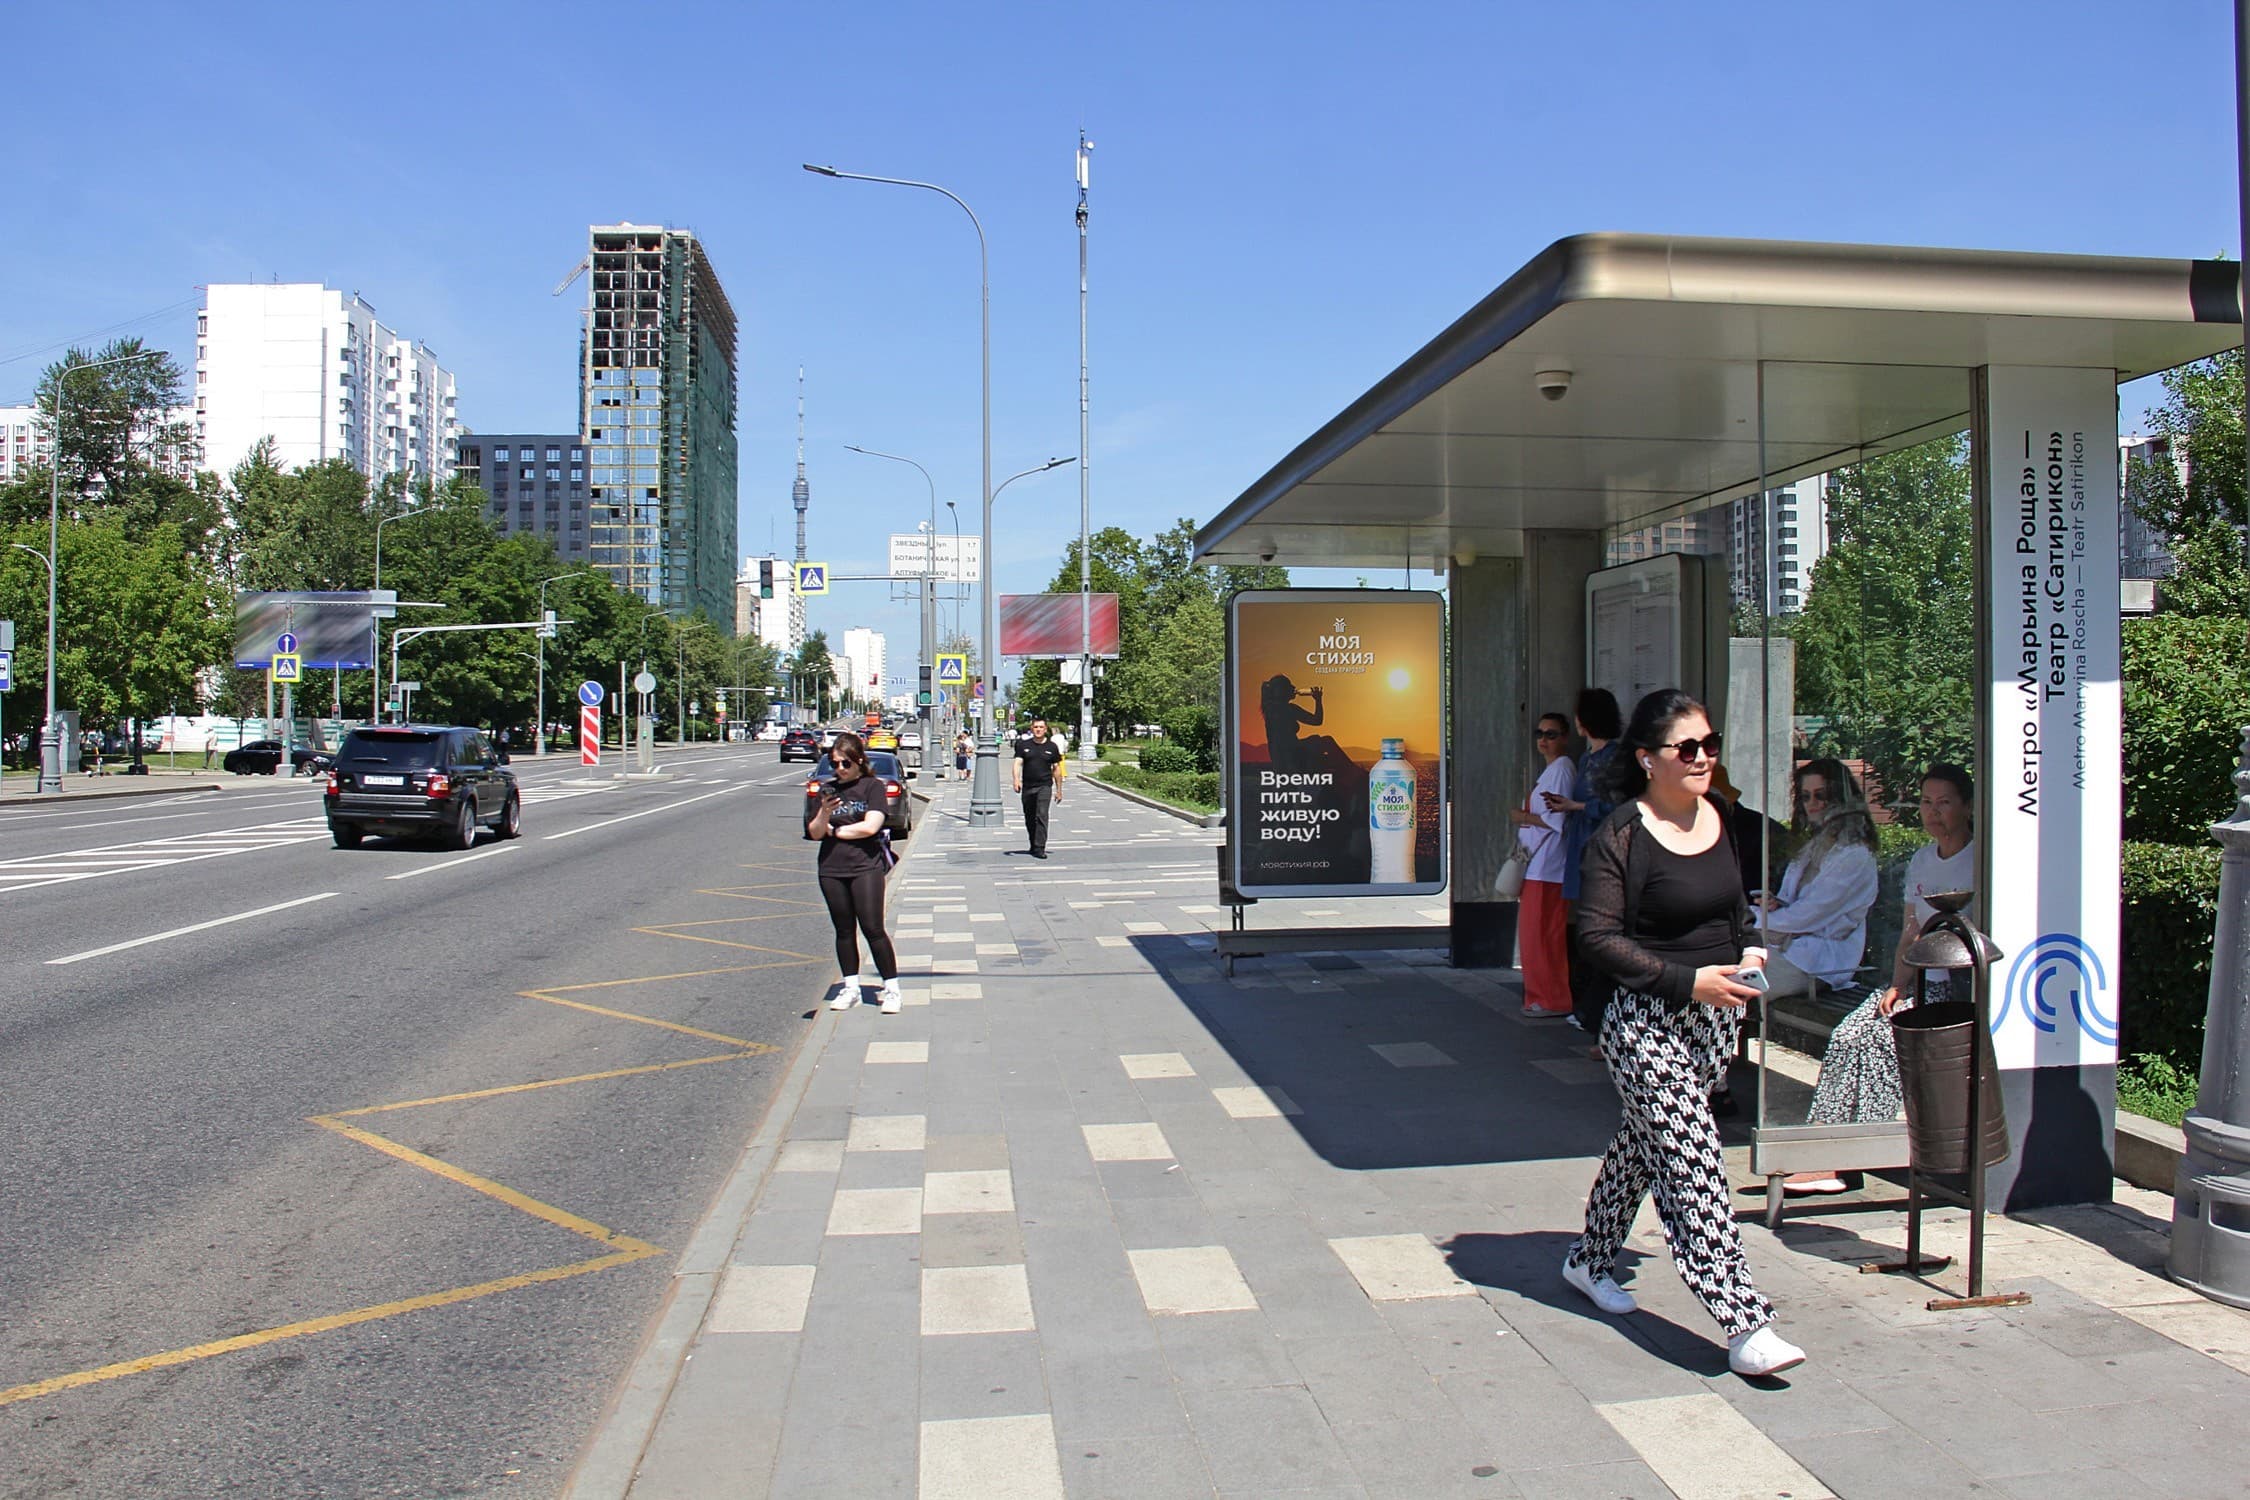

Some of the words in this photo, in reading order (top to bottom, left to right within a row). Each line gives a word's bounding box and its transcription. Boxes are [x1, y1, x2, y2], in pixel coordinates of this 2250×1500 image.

[2070, 431, 2085, 511] Satirikon
[2016, 466, 2039, 554] Роща»
[2044, 431, 2069, 613] «Сатирикон»
[2071, 517, 2085, 561] Teatr
[1319, 635, 1360, 650] МОЯ
[2017, 564, 2042, 712] «Марьина
[2071, 588, 2086, 650] Roscha
[1306, 652, 1374, 665] СТИХИЯ
[2046, 622, 2069, 702] Театр
[2072, 655, 2089, 729] Maryina
[1260, 771, 1333, 788] Время
[2017, 721, 2042, 816] Метро
[2072, 735, 2087, 790] Metro
[1260, 791, 1313, 804] пить
[1260, 809, 1340, 824] живую
[1377, 803, 1410, 811] СТИХИЯ
[1383, 795, 1404, 804] МОЯ
[1260, 824, 1321, 842] воду!
